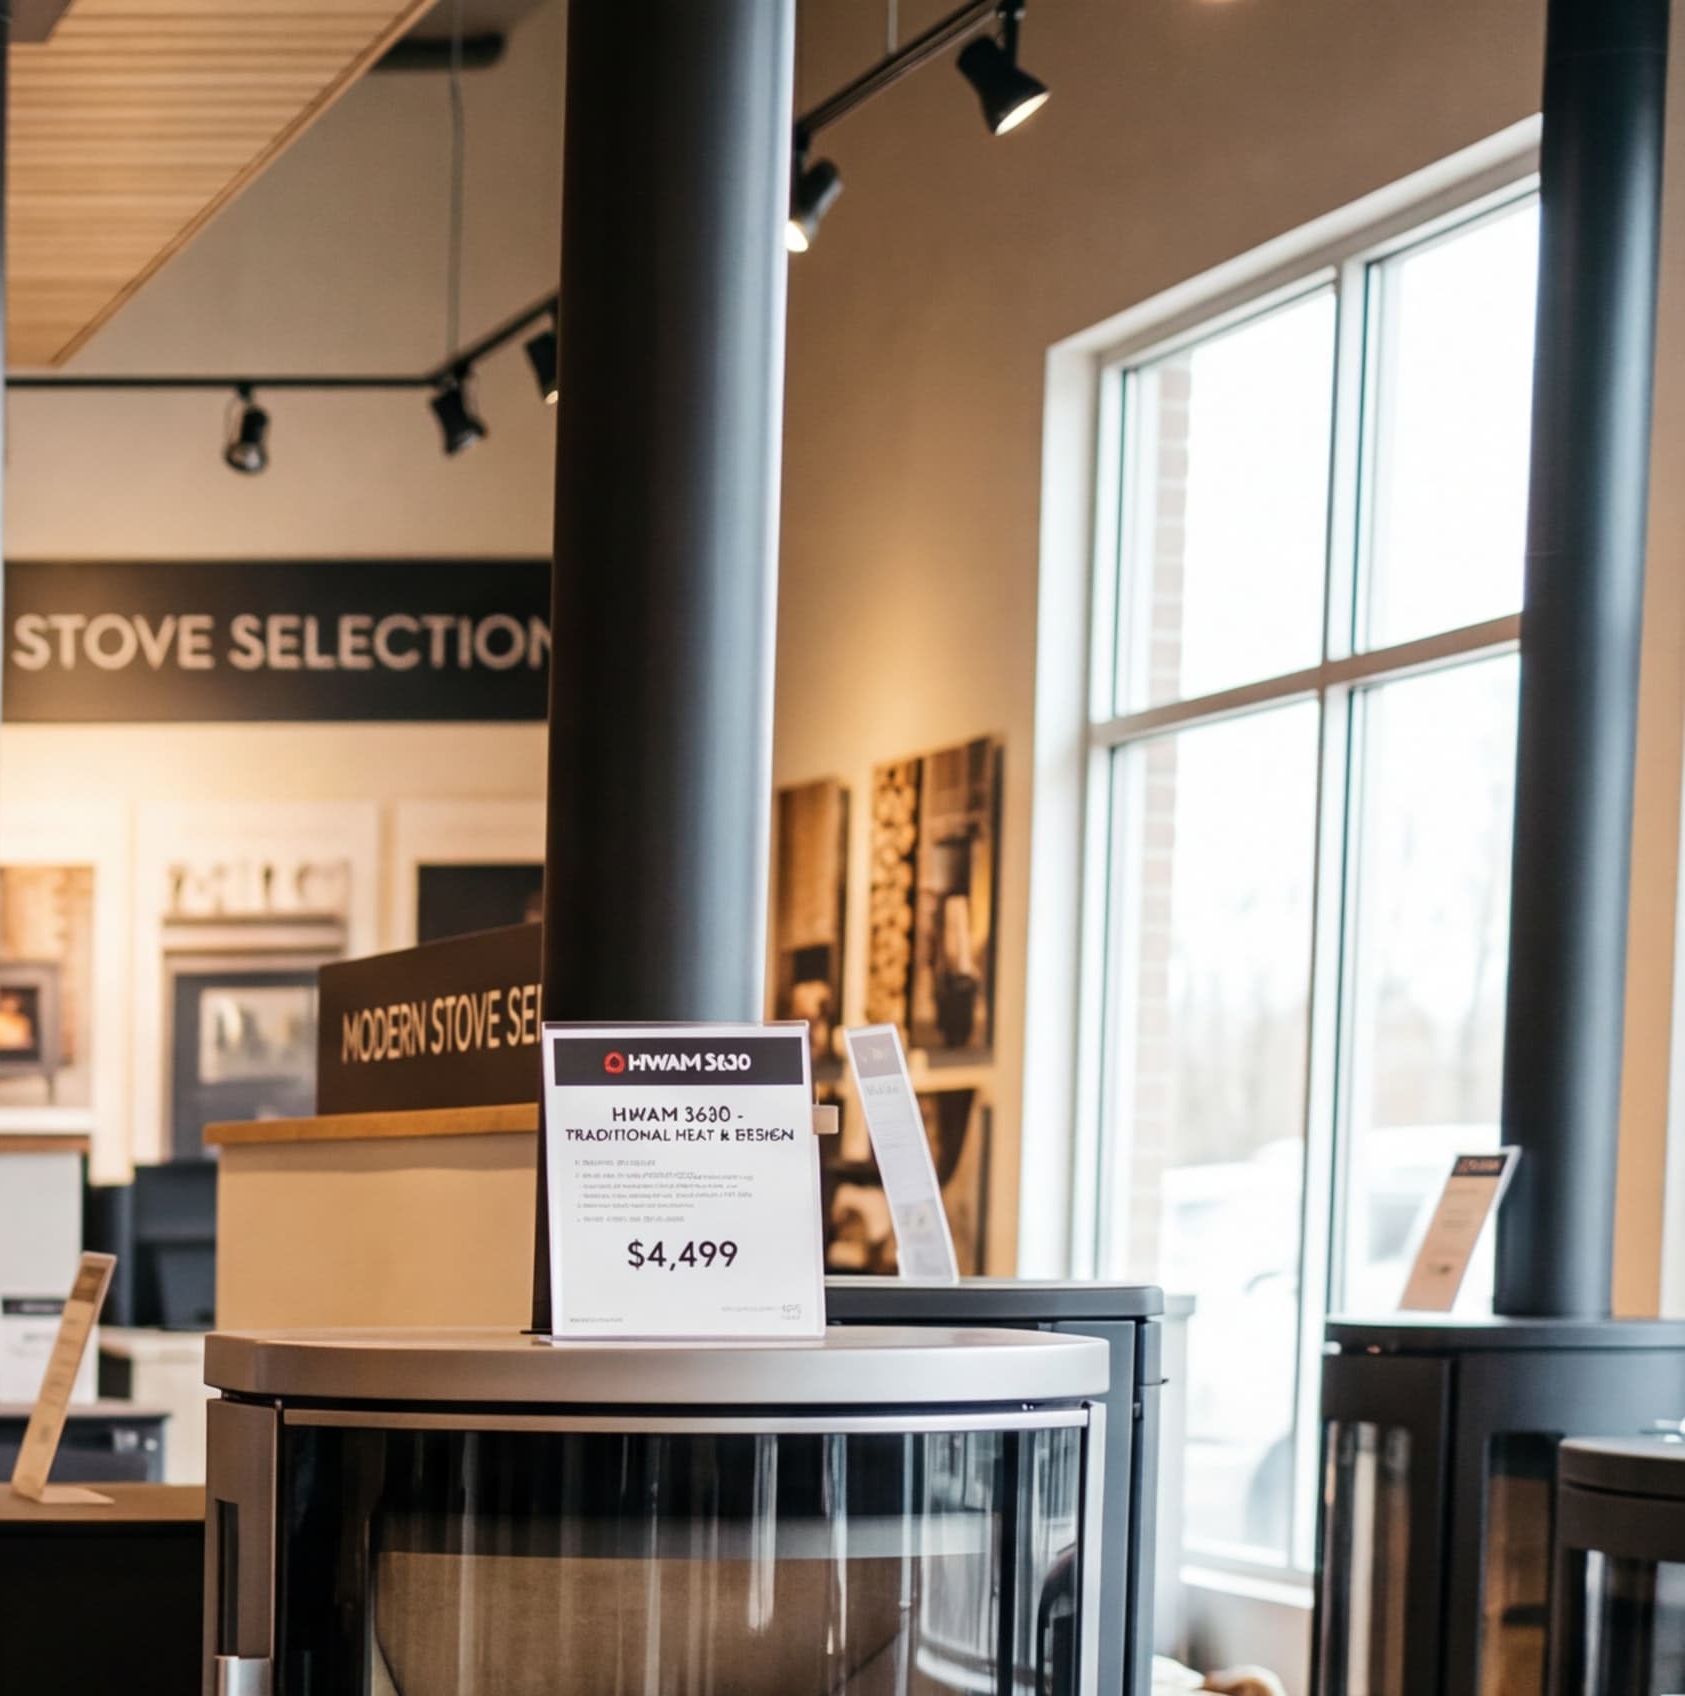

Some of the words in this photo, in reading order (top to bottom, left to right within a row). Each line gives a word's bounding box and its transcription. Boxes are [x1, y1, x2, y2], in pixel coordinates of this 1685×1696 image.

[12, 613, 215, 671] STOVE
[341, 1001, 427, 1064] MODERN
[430, 989, 502, 1056] STOVE
[628, 1053, 702, 1072] HWAM
[612, 1105, 679, 1122] HWAM
[627, 1238, 739, 1272] $4,499
